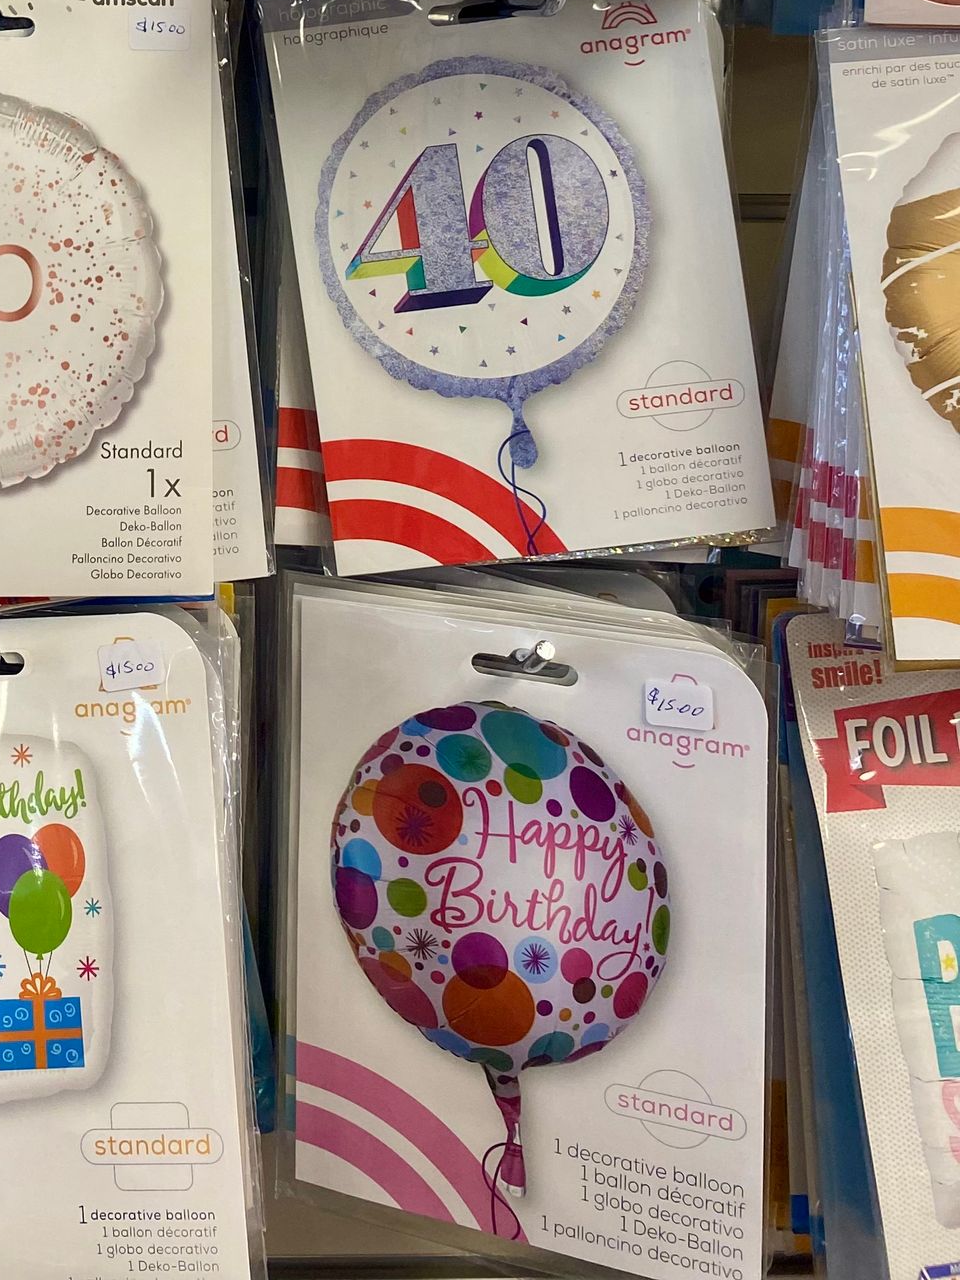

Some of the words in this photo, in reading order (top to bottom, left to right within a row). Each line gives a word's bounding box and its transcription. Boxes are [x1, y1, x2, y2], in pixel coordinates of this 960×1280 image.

[838, 38, 878, 51] satin
[842, 64, 882, 77] enrichi
[885, 64, 906, 75] par
[909, 62, 931, 72] des
[871, 79, 887, 89] de
[890, 77, 920, 88] satin
[344, 133, 610, 315] 40
[628, 383, 734, 411] standard
[100, 439, 183, 460] Standard
[618, 451, 628, 467] 1
[629, 447, 693, 463] decorative
[695, 443, 741, 455] balloon
[146, 468, 182, 498] 1x
[86, 505, 141, 516] Decorative
[143, 504, 182, 516] Balloon
[120, 521, 182, 532] Deko-Ballon
[101, 537, 133, 548] Ballon
[136, 536, 182, 548] Décoratif
[71, 554, 124, 564] Palloncino
[127, 553, 182, 564] Decorativo
[90, 569, 124, 580] Globo
[127, 569, 182, 580] Decorativo
[810, 659, 883, 690] smile!
[74, 699, 192, 724] anagam
[844, 714, 949, 770] FOIL
[462, 786, 628, 903] Happy
[424, 856, 655, 982] Birthday!
[617, 1093, 734, 1132] standard
[94, 1133, 211, 1156] standard
[553, 1138, 562, 1155] 1
[567, 1142, 668, 1180] decorative
[672, 1165, 745, 1199] balloon
[581, 1164, 589, 1182] 1
[594, 1167, 652, 1197] ballon
[657, 1185, 746, 1219] décoratif
[78, 1205, 88, 1225] 1
[90, 1209, 162, 1221] decorative
[166, 1209, 216, 1221] balloon
[580, 1185, 589, 1202] 1
[594, 1192, 643, 1211] globo
[648, 1204, 744, 1240] decorativo
[102, 1226, 108, 1238] 1
[112, 1227, 153, 1238] ballon
[157, 1226, 218, 1238] décoratif
[620, 1215, 628, 1233] 1
[633, 1219, 744, 1261] Deko-Ballon
[97, 1243, 103, 1255] 1
[106, 1244, 143, 1259] globo
[147, 1243, 219, 1255] decorativo
[541, 1215, 549, 1232] 1
[553, 1223, 643, 1256] palloncino
[647, 1245, 743, 1280] decorativo
[128, 1260, 134, 1272] 1
[138, 1260, 220, 1272] Deko-Ballon
